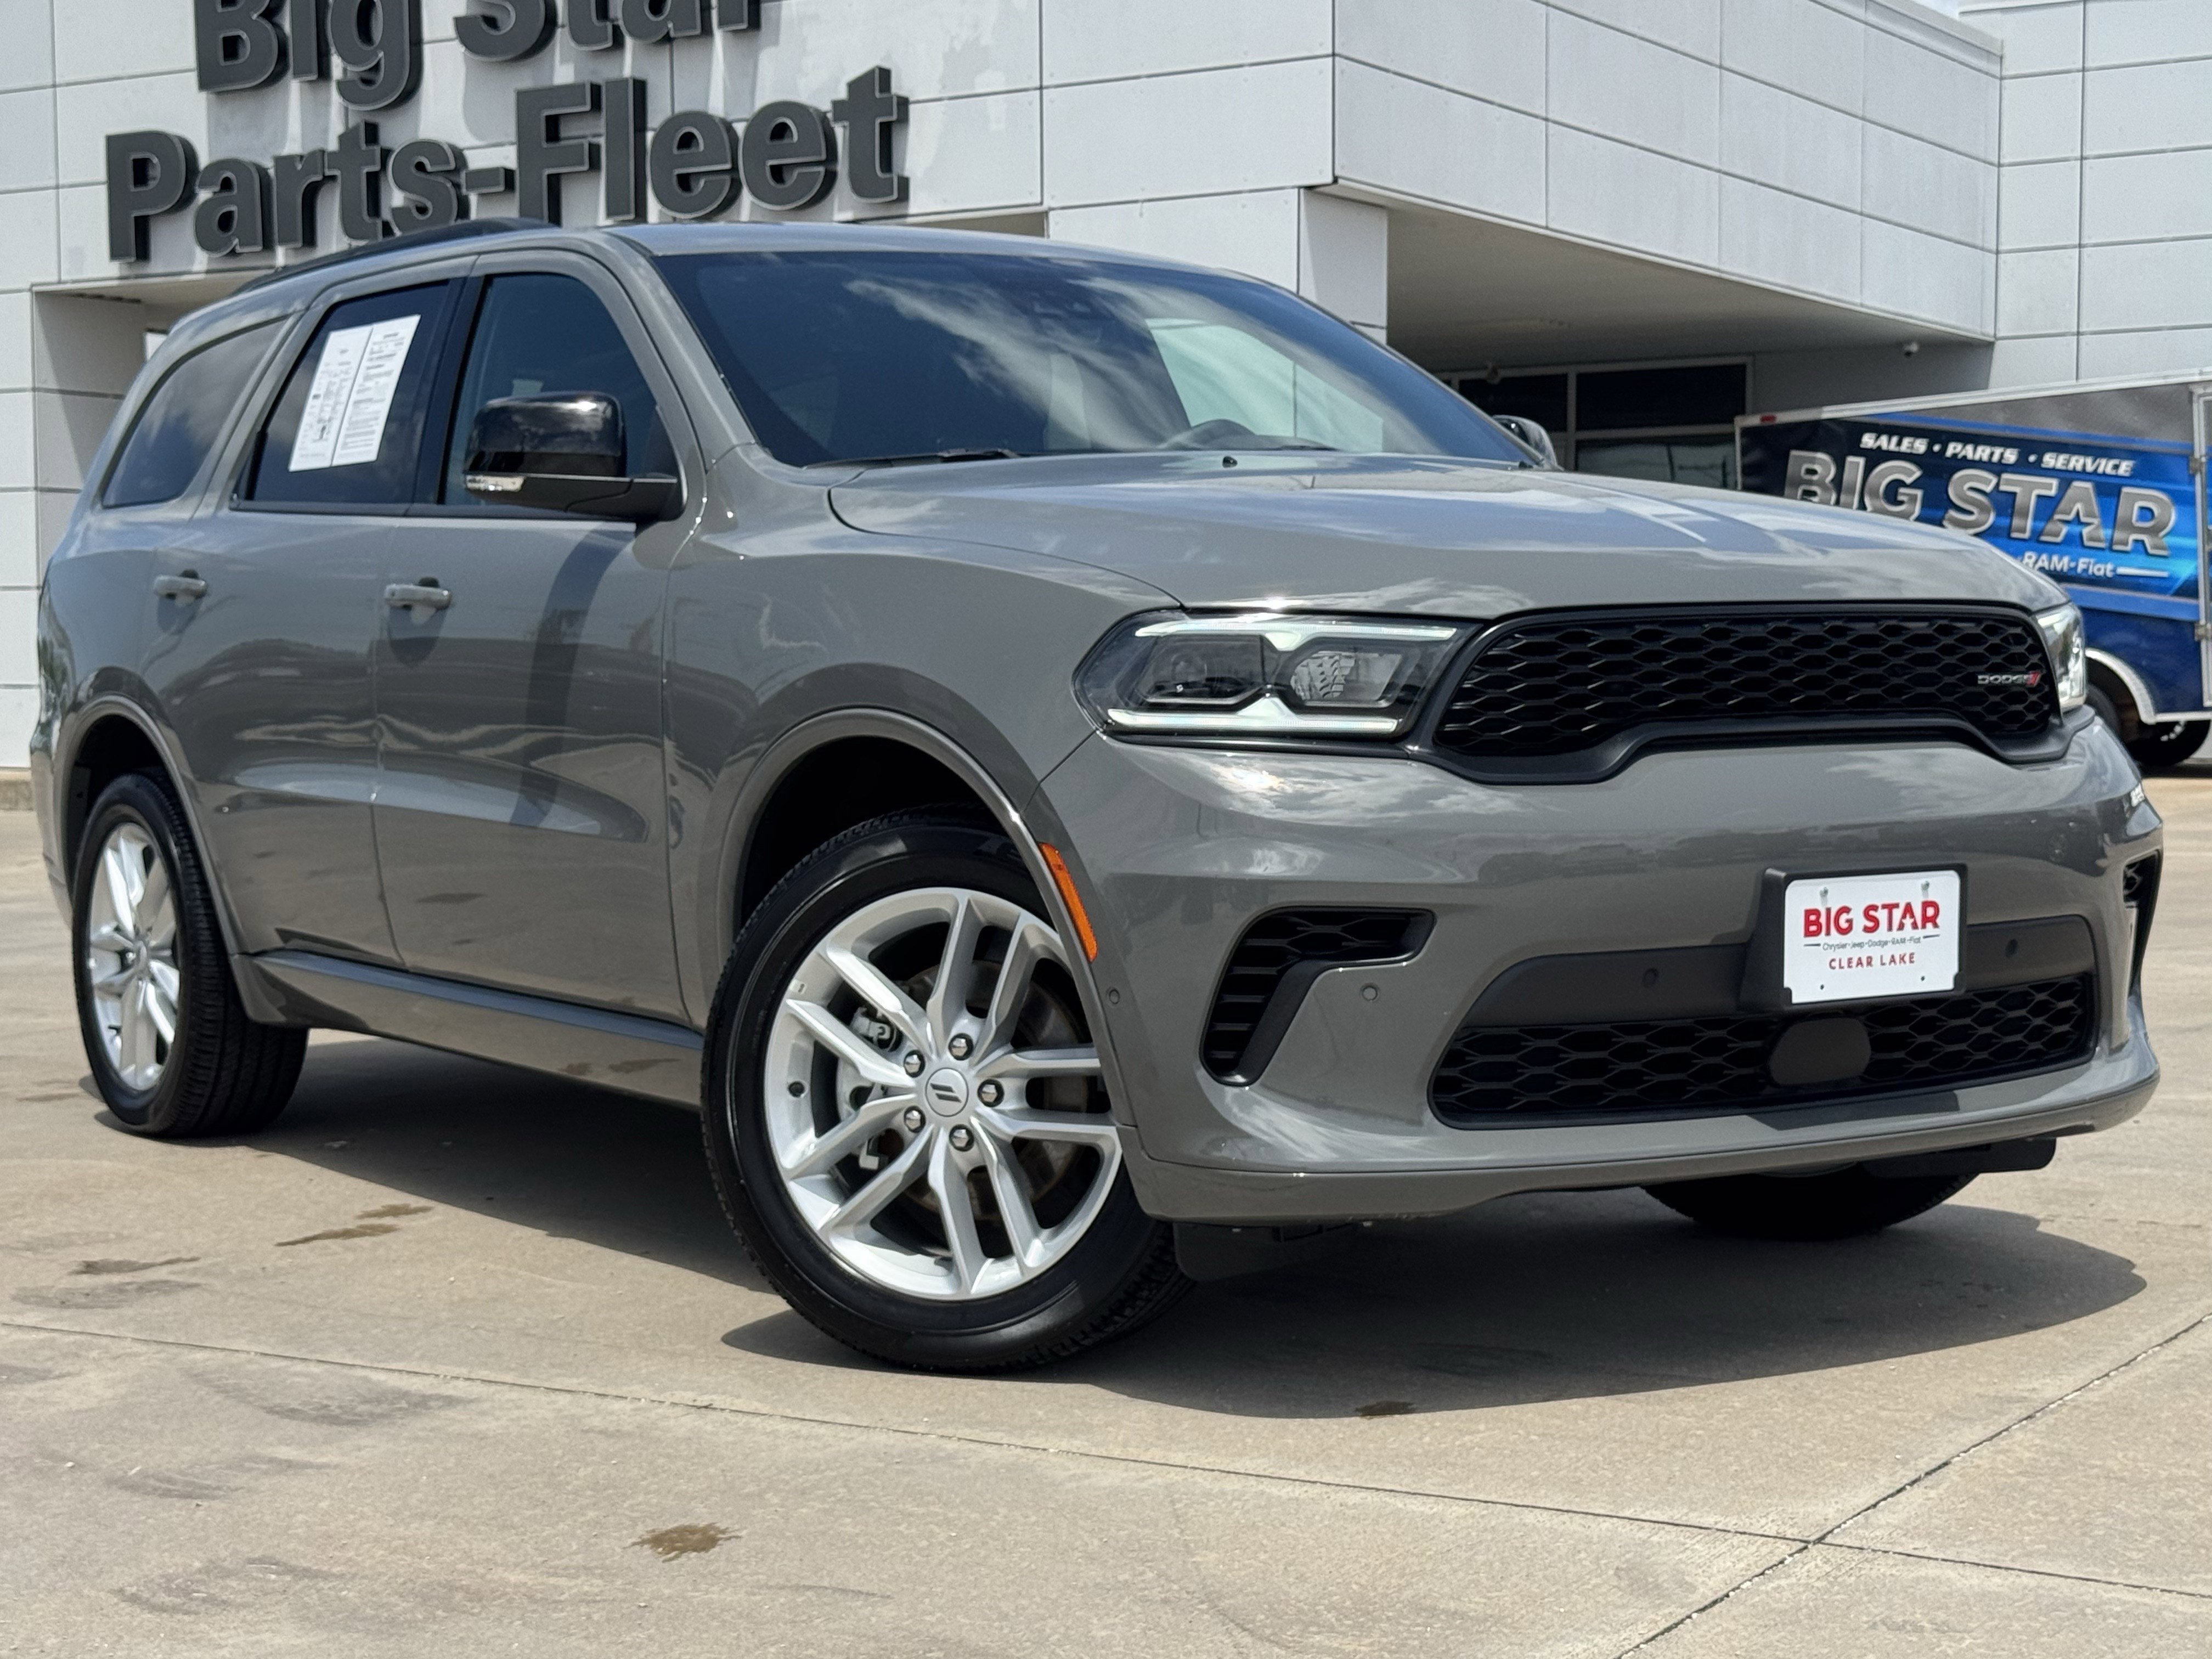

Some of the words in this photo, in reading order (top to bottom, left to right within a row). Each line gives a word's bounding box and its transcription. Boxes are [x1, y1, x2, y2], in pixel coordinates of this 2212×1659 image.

[106, 66, 900, 262] Parts-Fleet
[1860, 432, 1929, 454] SALES
[1945, 442, 2020, 465] PARTS
[2041, 452, 2137, 477] SERVICE
[1784, 449, 1923, 522] BIG
[1942, 468, 2176, 557] STAR
[1803, 906, 1853, 938] BIG
[1862, 900, 1940, 933] STAR
[1829, 955, 1874, 970] CLEAR
[1880, 952, 1916, 967] LAKE
